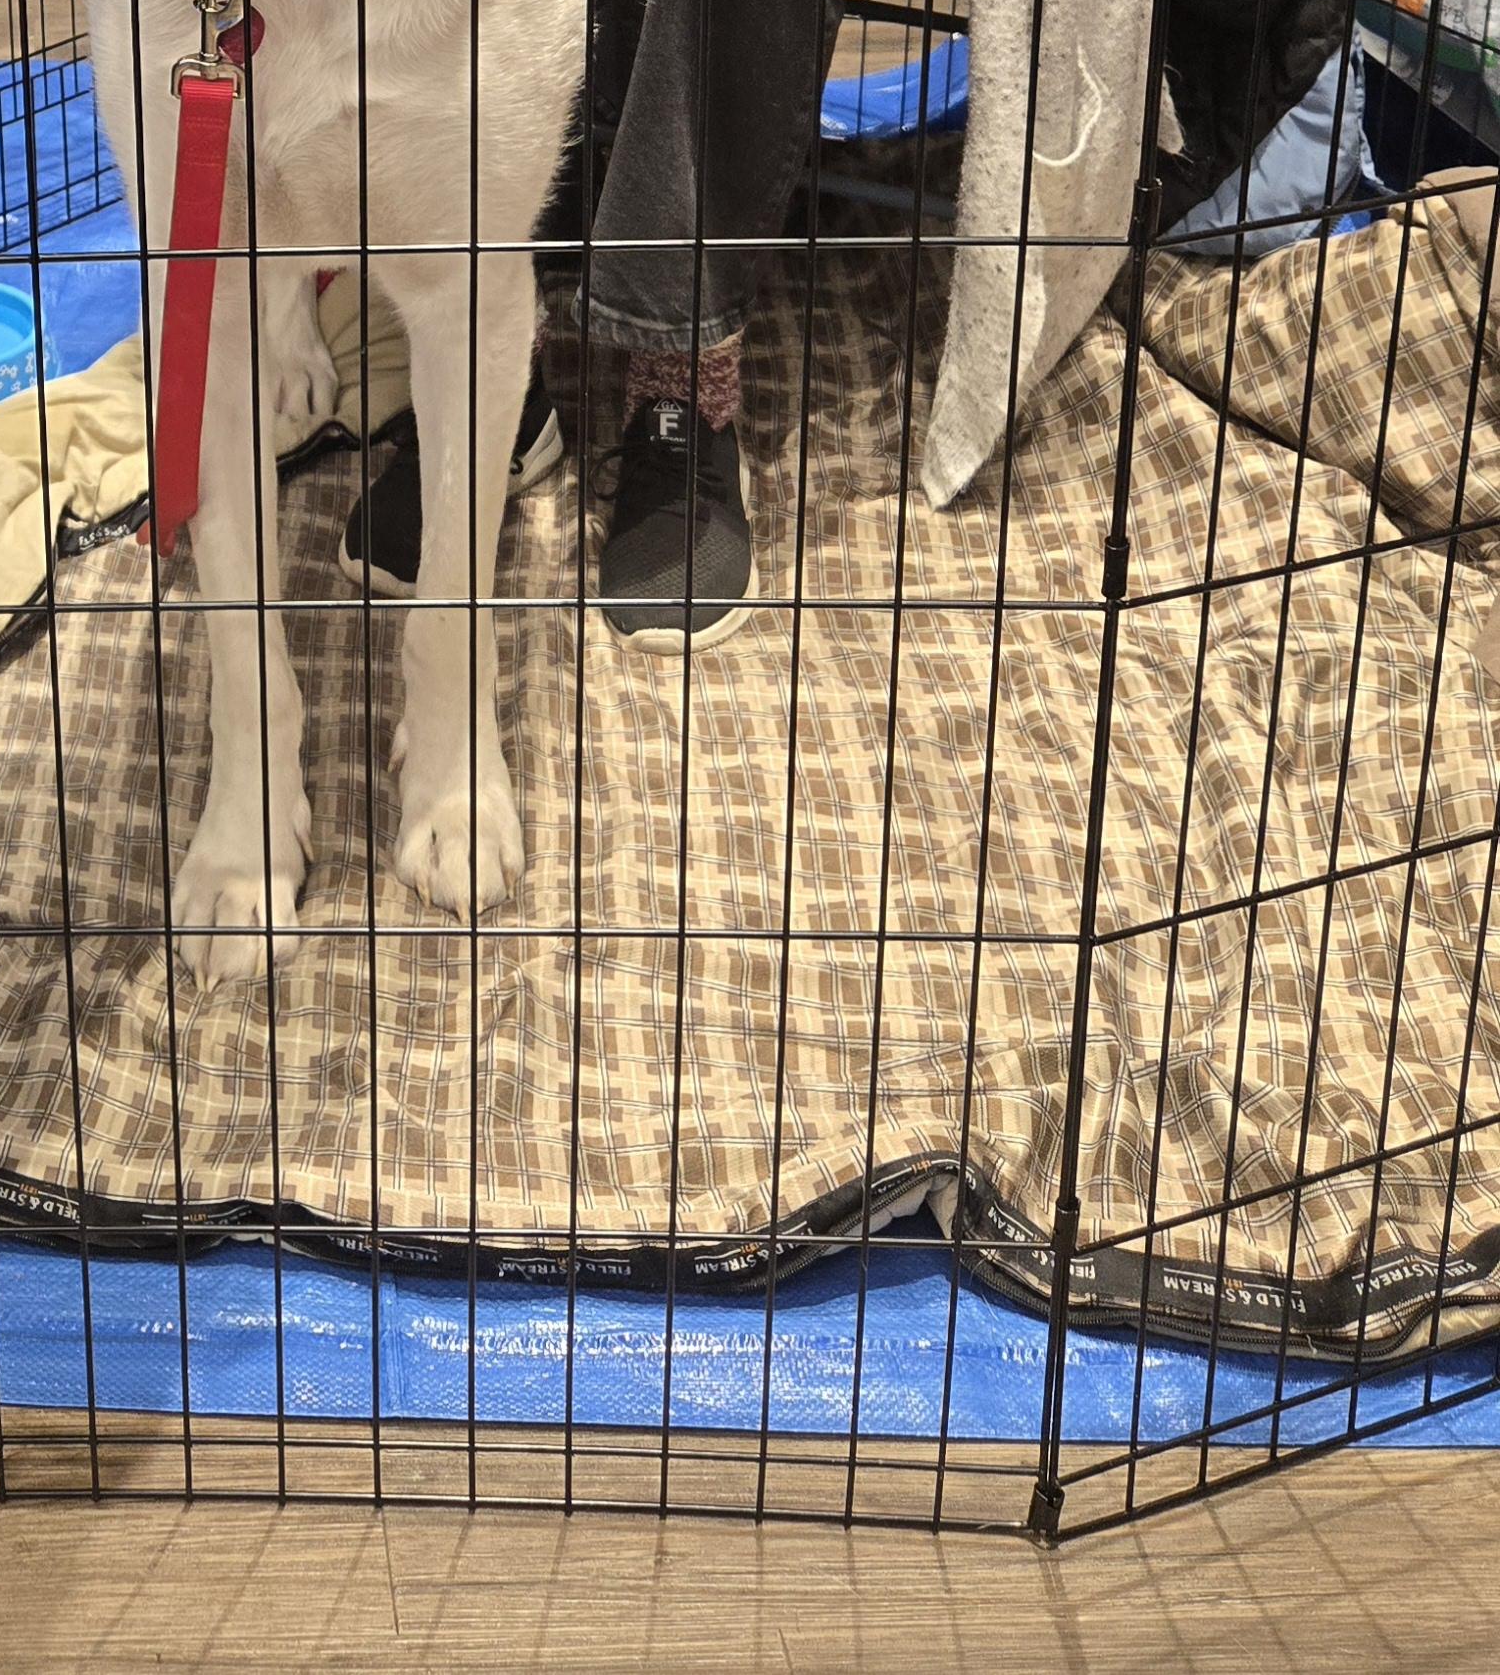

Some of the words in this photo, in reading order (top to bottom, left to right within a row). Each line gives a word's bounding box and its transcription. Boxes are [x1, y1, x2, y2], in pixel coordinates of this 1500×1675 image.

[659, 412, 679, 437] F
[587, 1261, 632, 1276] FIELD
[695, 1253, 757, 1276] STREAM
[1238, 1290, 1252, 1305] &
